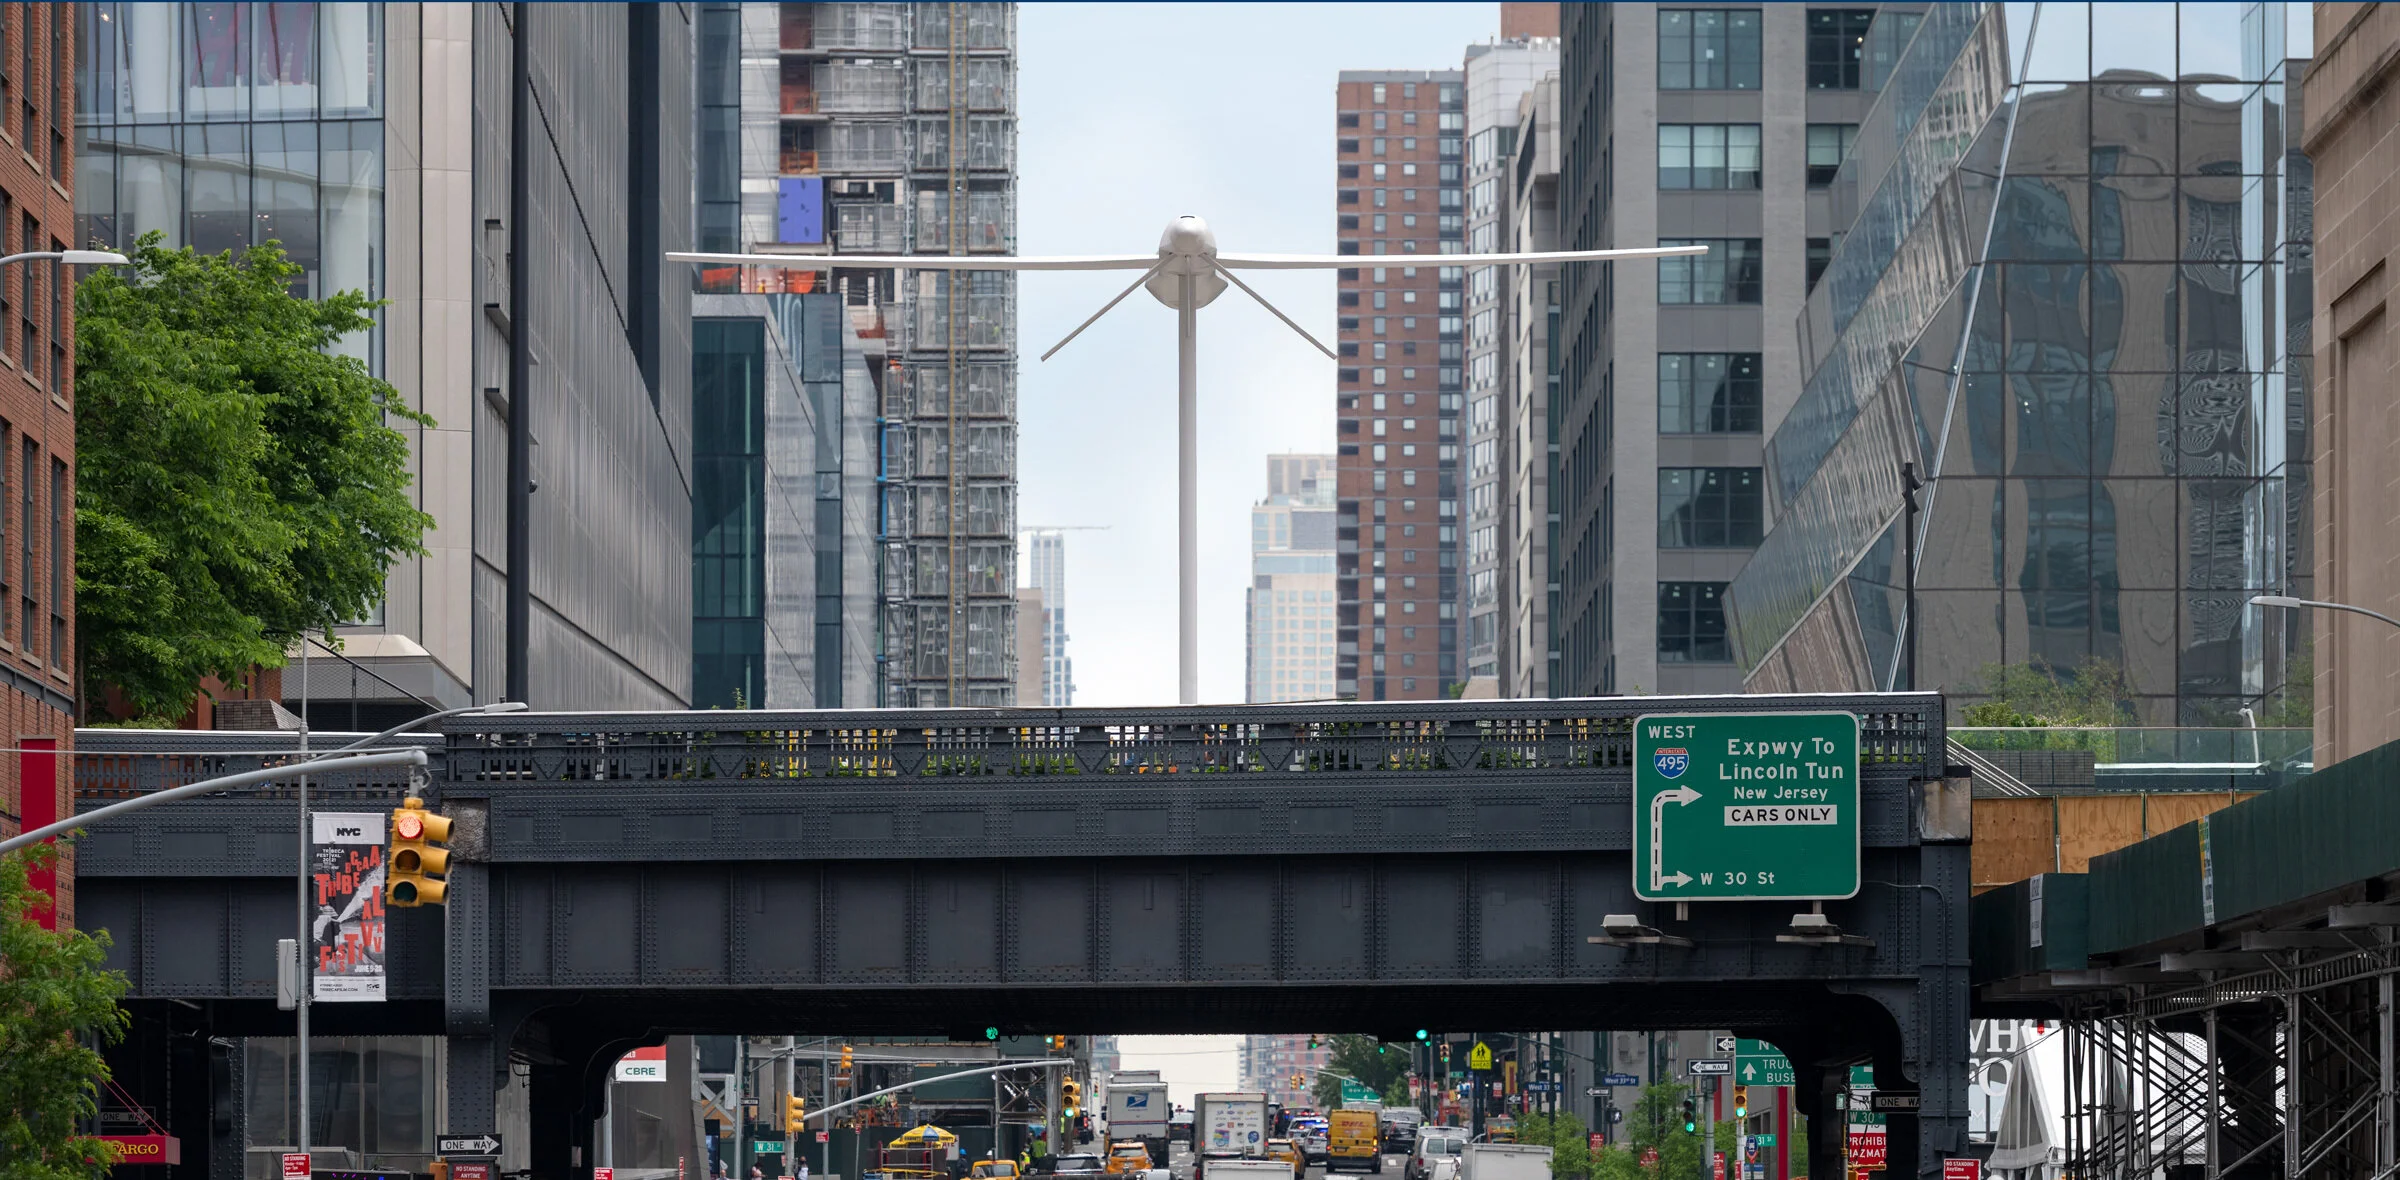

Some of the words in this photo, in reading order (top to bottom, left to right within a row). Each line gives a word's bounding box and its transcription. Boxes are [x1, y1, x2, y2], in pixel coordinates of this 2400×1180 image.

[1648, 725, 1696, 739] WEST
[1727, 738, 1803, 759] Expwy
[1811, 737, 1835, 755] To
[1657, 755, 1686, 771] 495
[1719, 763, 1798, 780] Lincoln
[1805, 762, 1844, 779] Tun
[1733, 786, 1767, 799] New
[1773, 786, 1828, 801] Jersey
[1731, 809, 1779, 822] CARS
[1785, 808, 1831, 821] ONLY
[336, 827, 361, 837] NYC
[1700, 872, 1713, 886] W
[1724, 871, 1747, 886] 30
[1757, 871, 1775, 885] St
[355, 964, 369, 973] JUNE
[1881, 1098, 1900, 1106] ONE
[1850, 1112, 1857, 1123] W
[1861, 1112, 1875, 1123] 30
[446, 1141, 464, 1149] ONE
[473, 1141, 493, 1149] WAY
[1757, 1136, 1765, 1145] 31
[758, 1143, 764, 1151] W
[766, 1143, 774, 1151] 31
